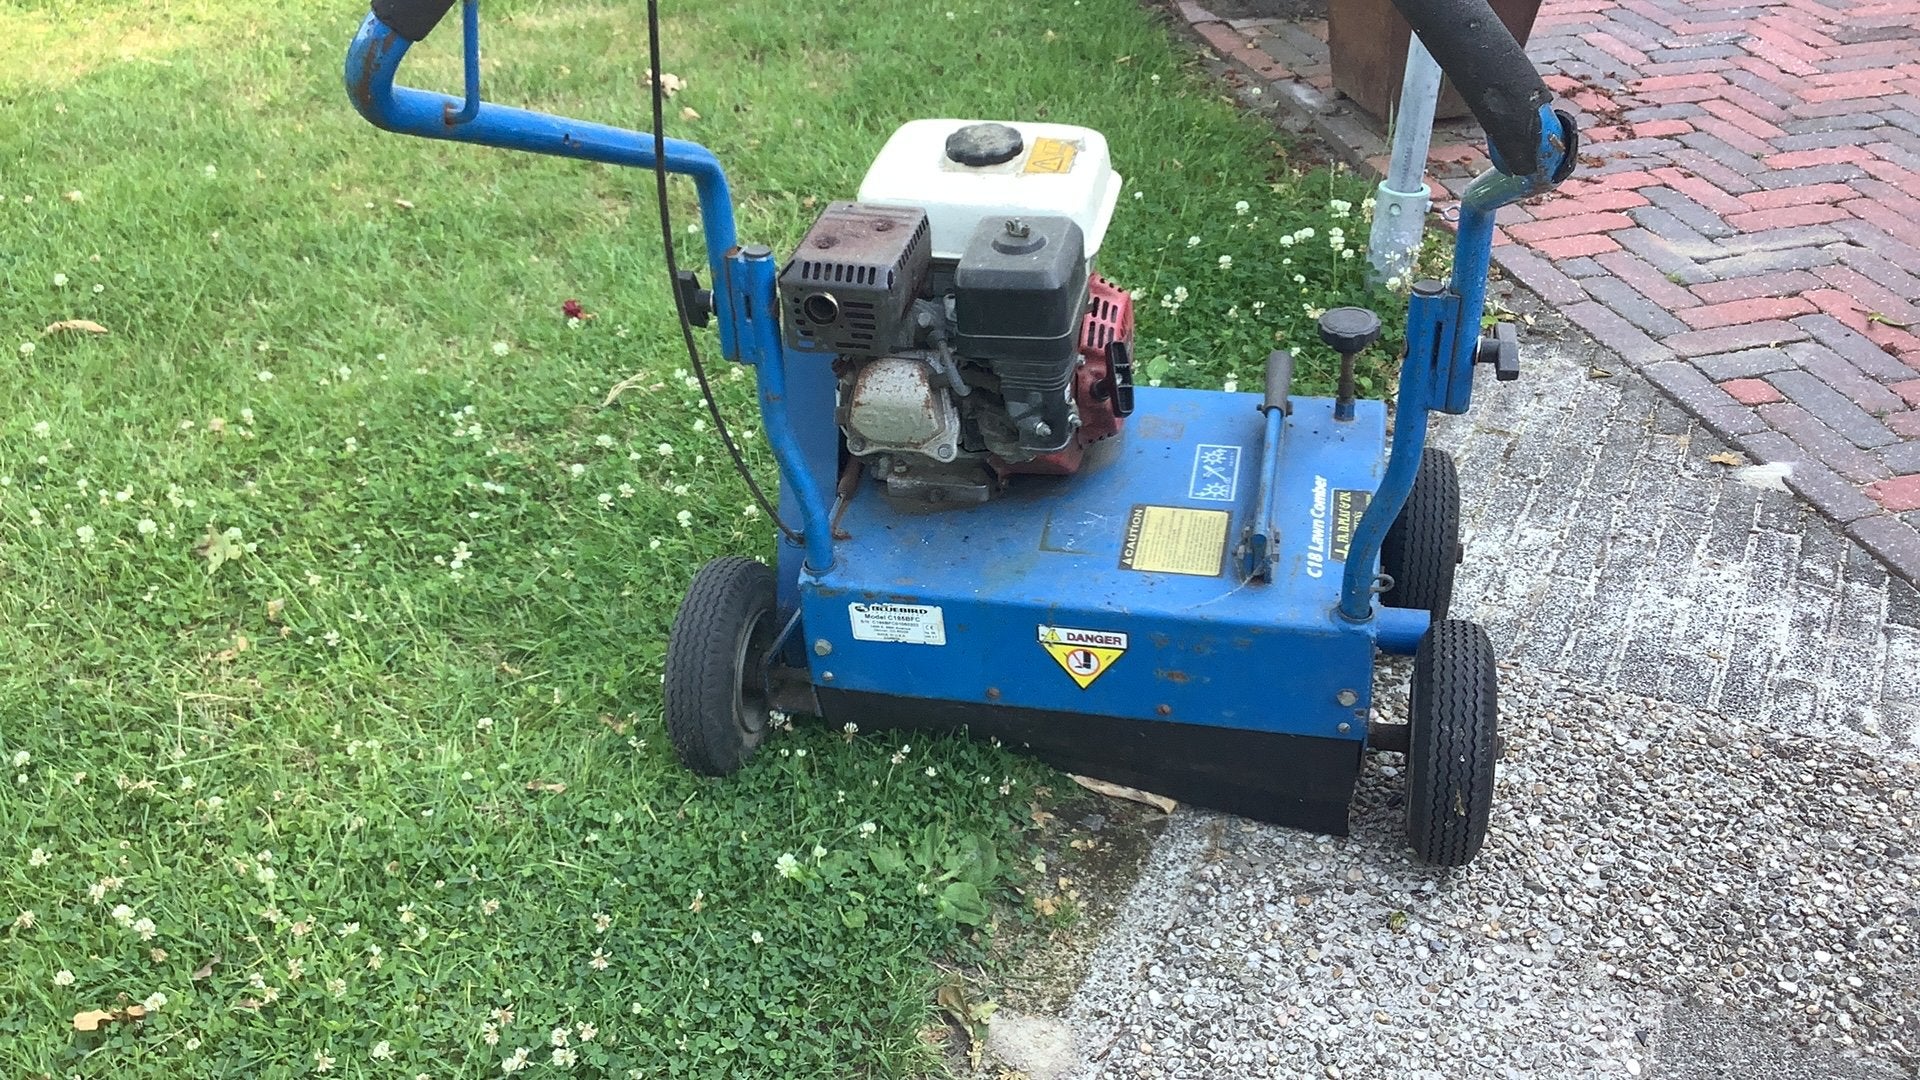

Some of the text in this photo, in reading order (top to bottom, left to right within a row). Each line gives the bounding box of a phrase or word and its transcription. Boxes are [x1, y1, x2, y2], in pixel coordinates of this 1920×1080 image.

[1124, 509, 1143, 557] CAUTION
[1307, 474, 1328, 578] C18 Lawn Comber
[865, 613, 887, 621] Model
[1066, 632, 1122, 646] DANGER
